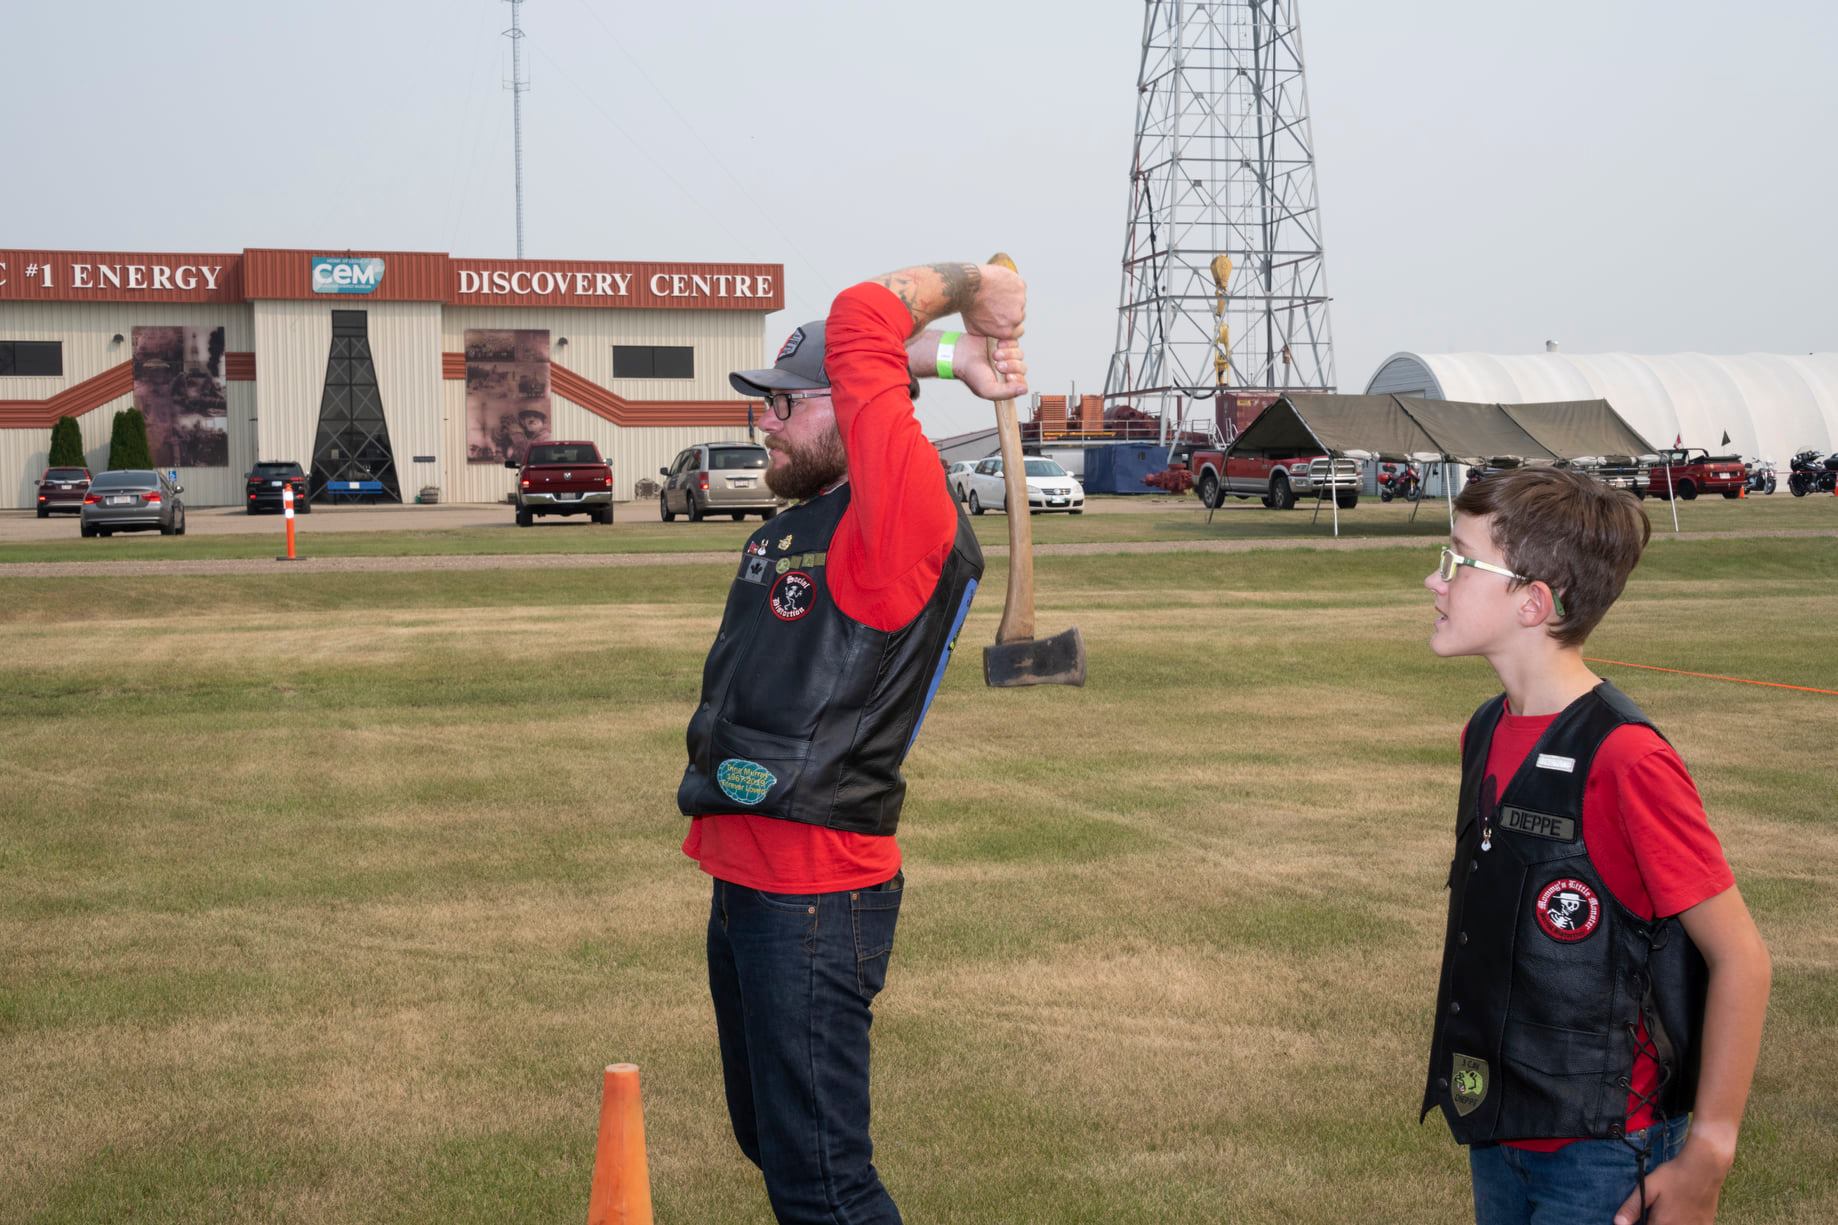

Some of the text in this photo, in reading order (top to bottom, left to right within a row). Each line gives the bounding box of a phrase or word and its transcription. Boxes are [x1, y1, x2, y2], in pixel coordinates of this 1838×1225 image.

[25, 263, 54, 287] #1
[71, 264, 222, 289] ENERGY
[458, 270, 773, 297] DISCOVERY CENTRE
[786, 575, 810, 589] Social
[772, 597, 805, 617] Distortion
[1509, 809, 1563, 837] DIEPPE
[1568, 879, 1591, 897] Little
[1585, 896, 1599, 930] Monster
